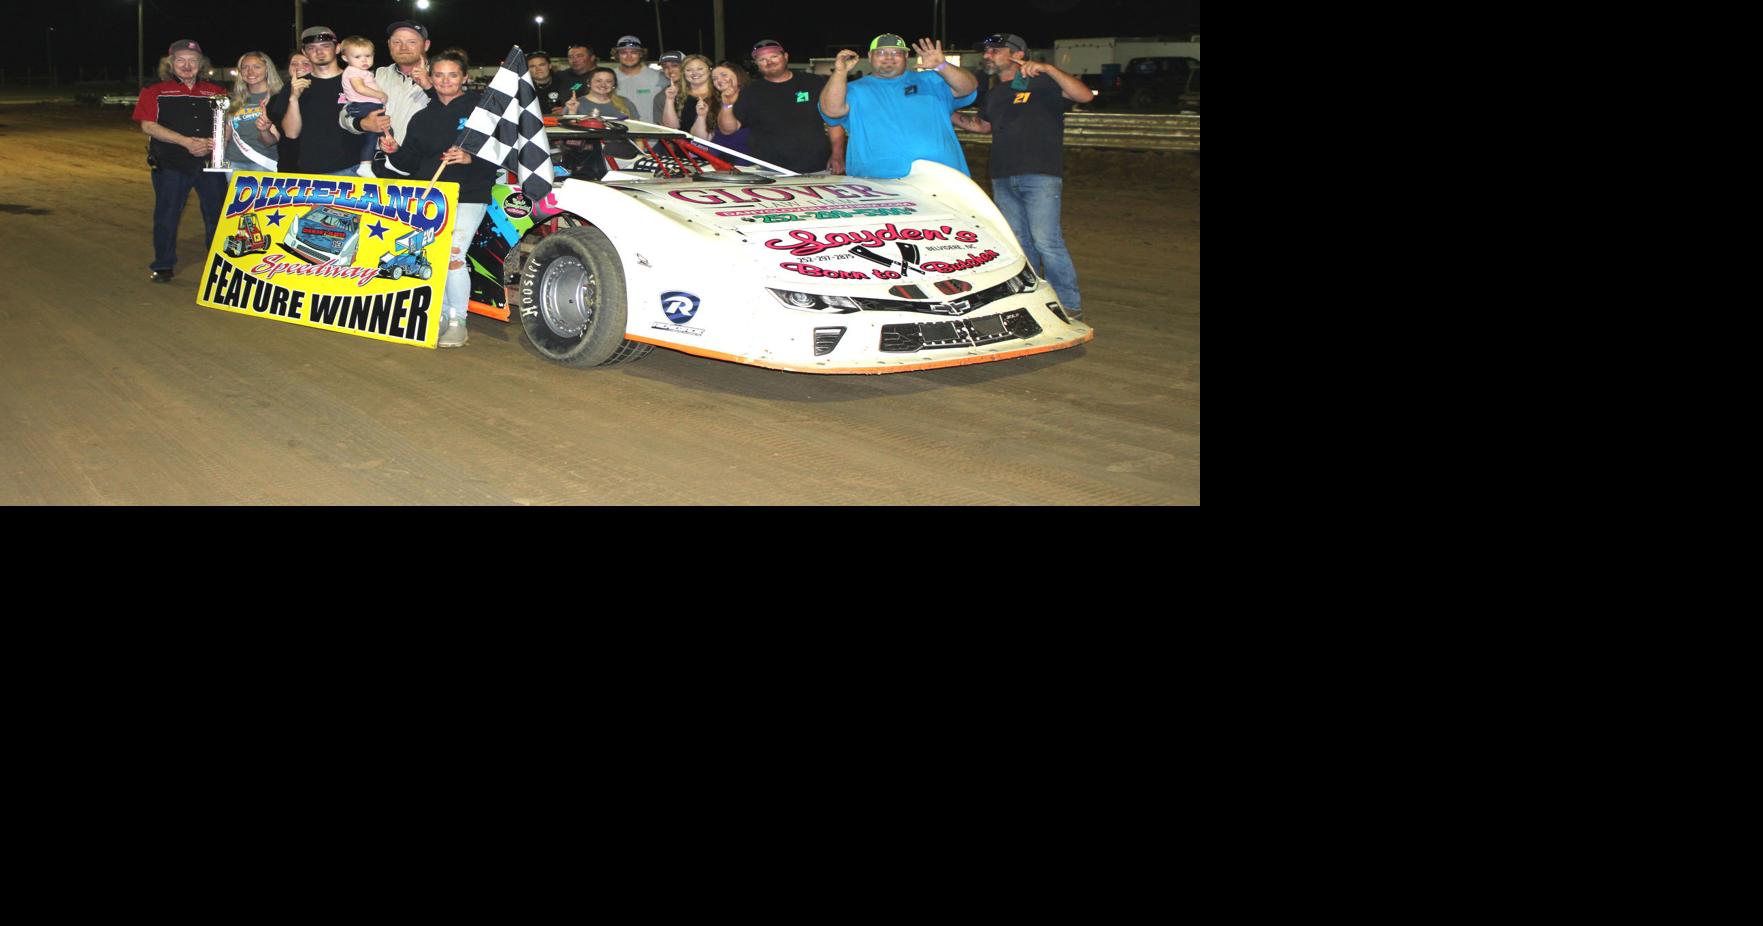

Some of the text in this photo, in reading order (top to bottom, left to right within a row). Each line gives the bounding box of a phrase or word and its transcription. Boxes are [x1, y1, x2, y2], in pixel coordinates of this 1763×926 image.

[795, 91, 809, 103] 21
[1013, 91, 1031, 104] 21
[226, 176, 448, 236] DIXIELAND
[667, 184, 900, 205] GLOVER
[251, 254, 381, 287] Speedway
[779, 249, 1000, 280] Born to Butcher
[203, 253, 432, 342] FEATURE WINNER
